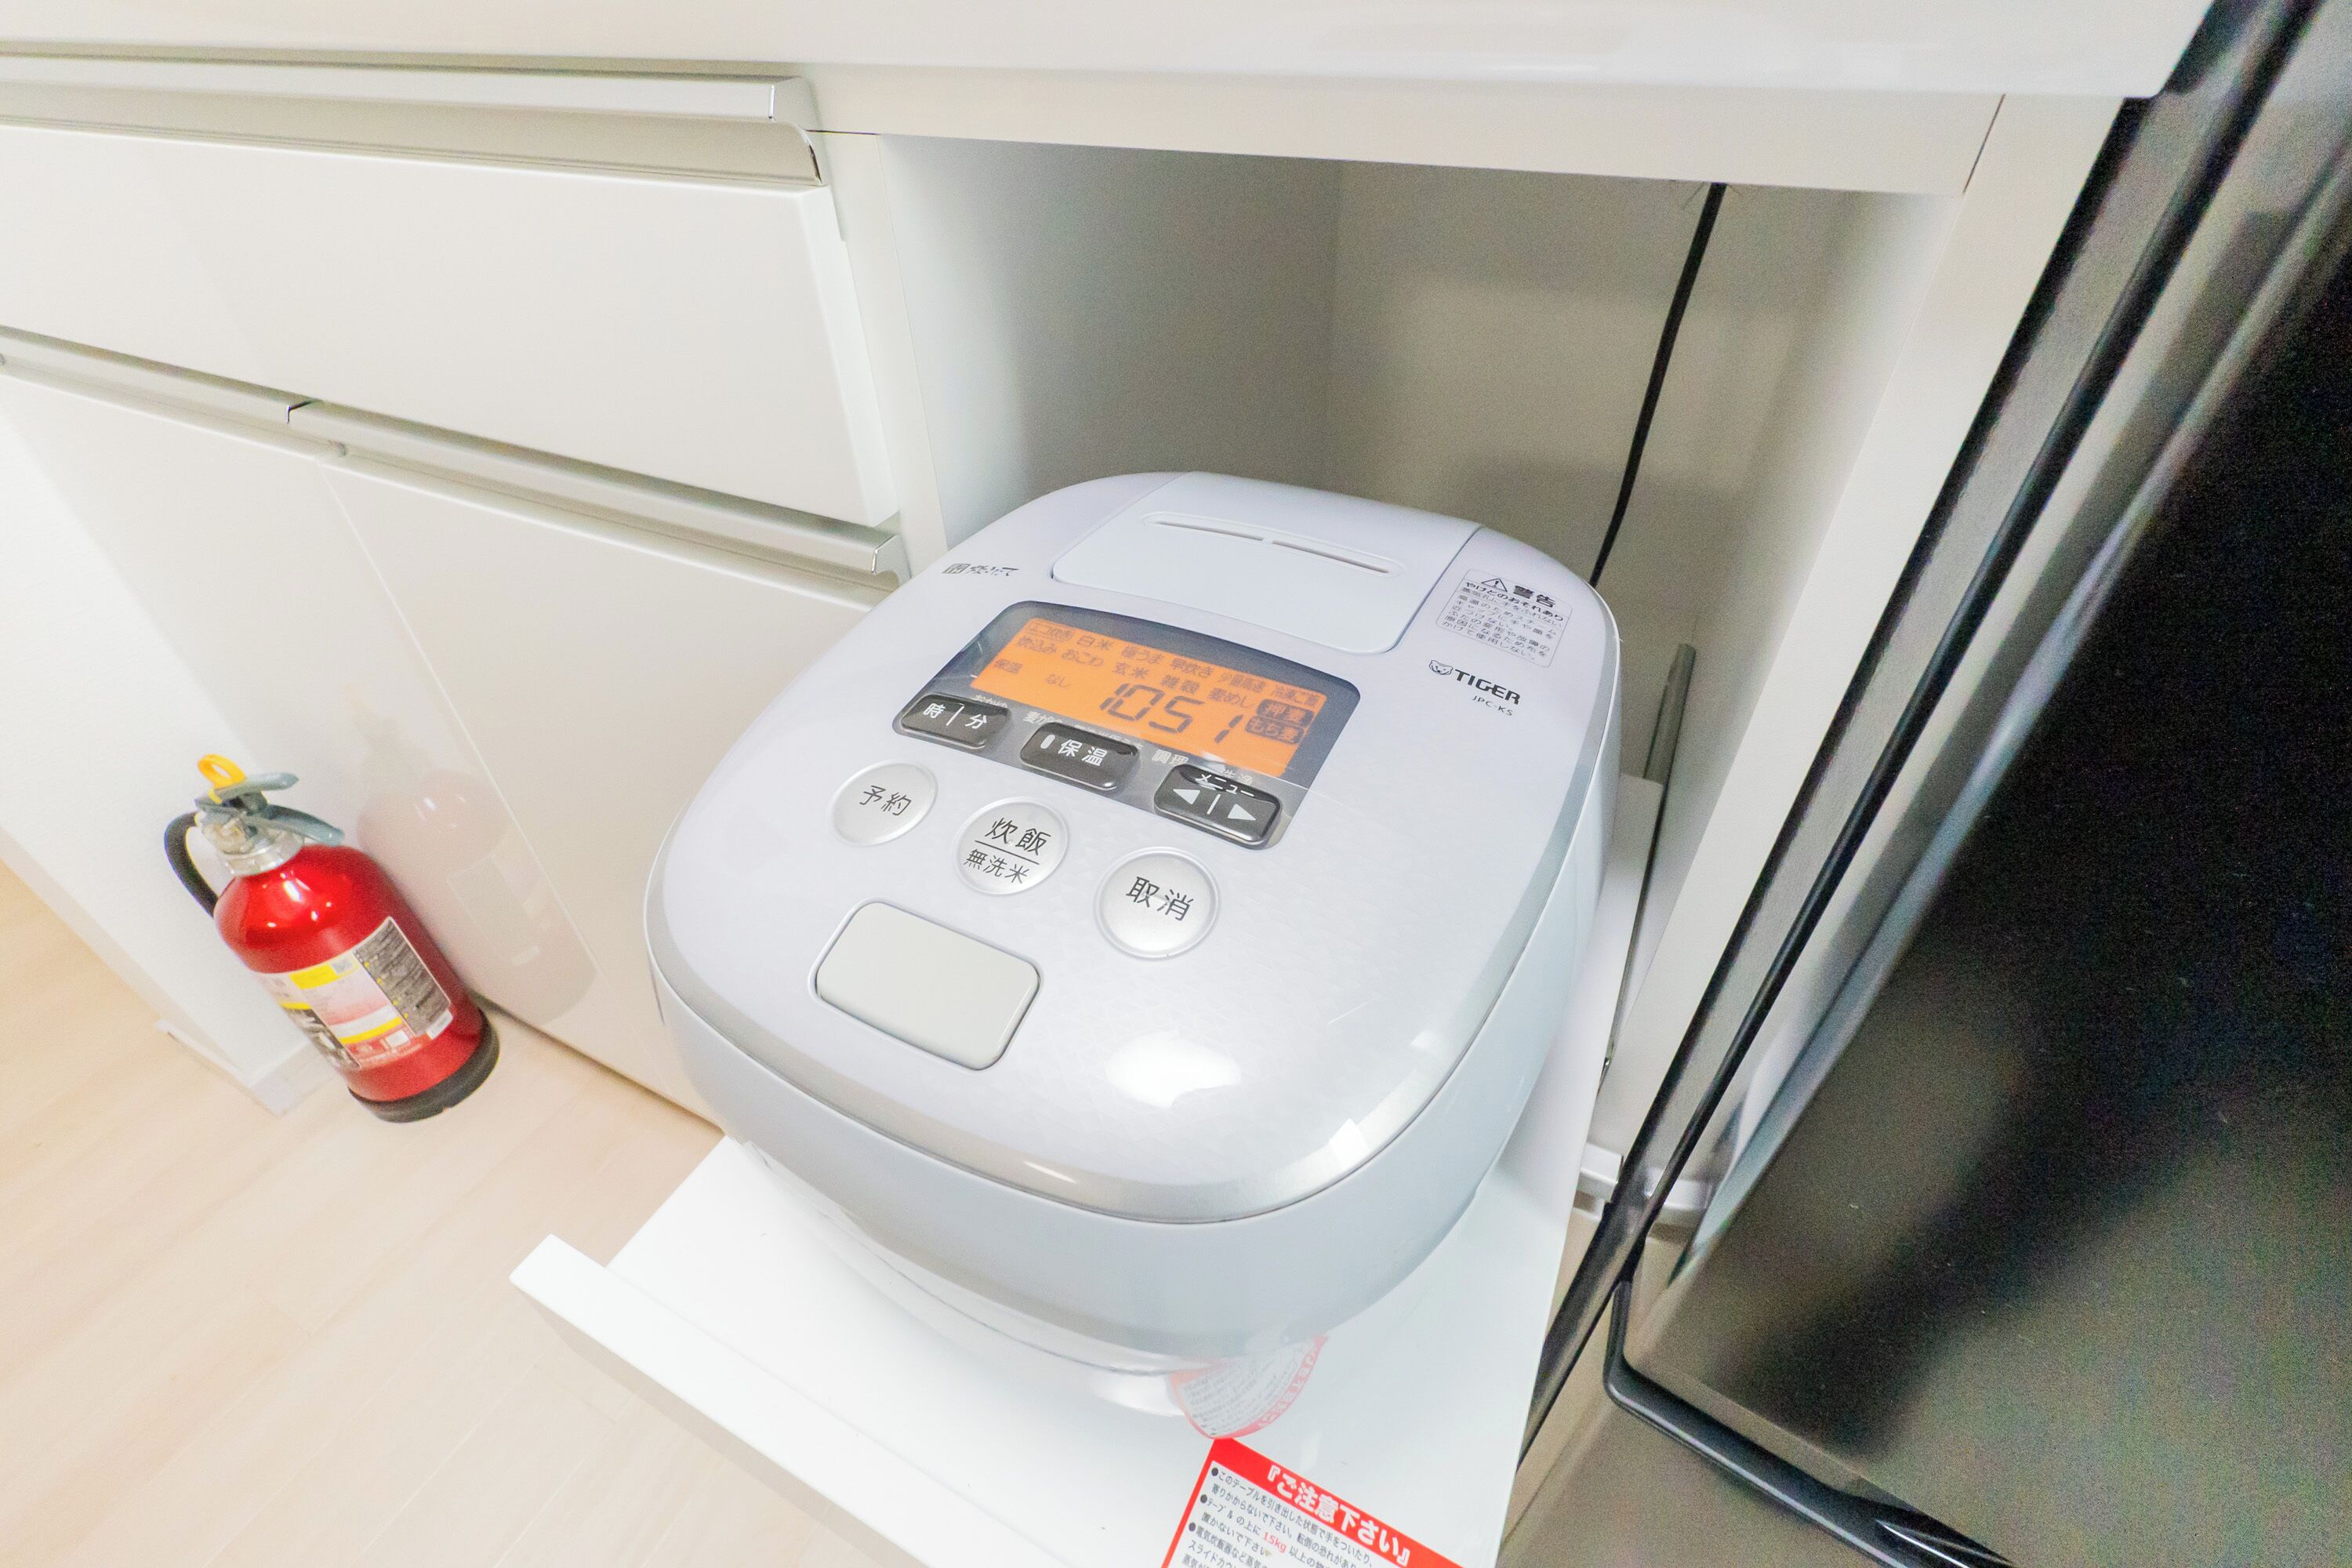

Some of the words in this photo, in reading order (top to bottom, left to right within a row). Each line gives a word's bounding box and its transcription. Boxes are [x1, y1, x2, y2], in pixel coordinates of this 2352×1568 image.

[1465, 581, 1564, 622] やけどのおそれあり
[1512, 585, 1556, 608] 警告
[1076, 633, 1113, 652] 白米
[1170, 657, 1214, 679] 早炊き
[1045, 673, 1072, 688] なし
[1061, 648, 1104, 666] おこわ
[1112, 662, 1150, 680] 玄米
[1160, 674, 1200, 695] 雑穀
[1207, 687, 1254, 708] 麦めし
[1454, 668, 1521, 706] TIGER
[922, 702, 946, 719] 時
[964, 713, 988, 730] 分
[1058, 739, 1108, 767] 保温
[1151, 749, 1189, 765] 調理
[859, 785, 913, 816] 予約
[1194, 773, 1255, 797] メニュー
[985, 817, 1051, 855] 炊飯
[964, 848, 1029, 884] 無洗米
[1126, 876, 1194, 921] 取消
[1262, 1531, 1287, 1554] 15kg
